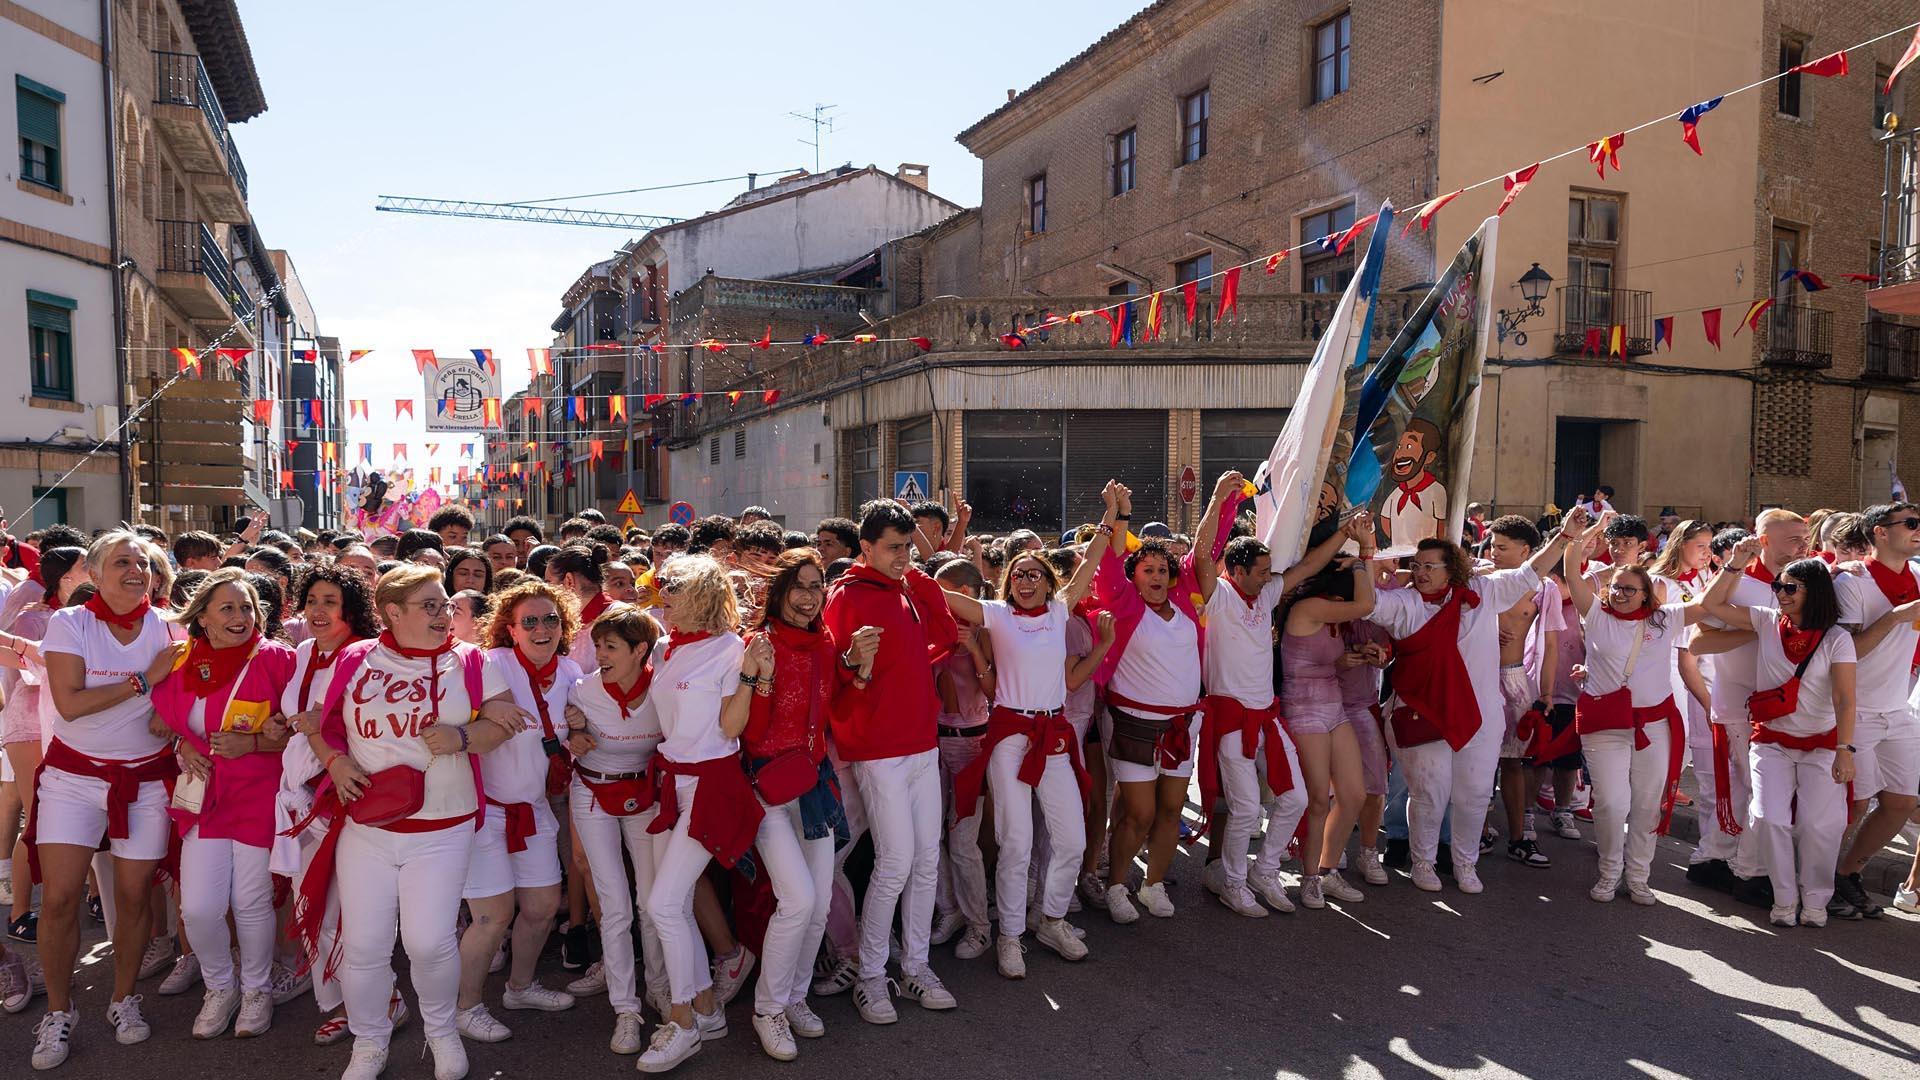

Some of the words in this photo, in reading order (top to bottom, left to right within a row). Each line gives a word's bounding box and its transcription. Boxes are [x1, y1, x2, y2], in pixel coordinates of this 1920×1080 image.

[1182, 480, 1195, 489] STOP
[352, 668, 447, 705] C'est
[355, 706, 384, 739] la
